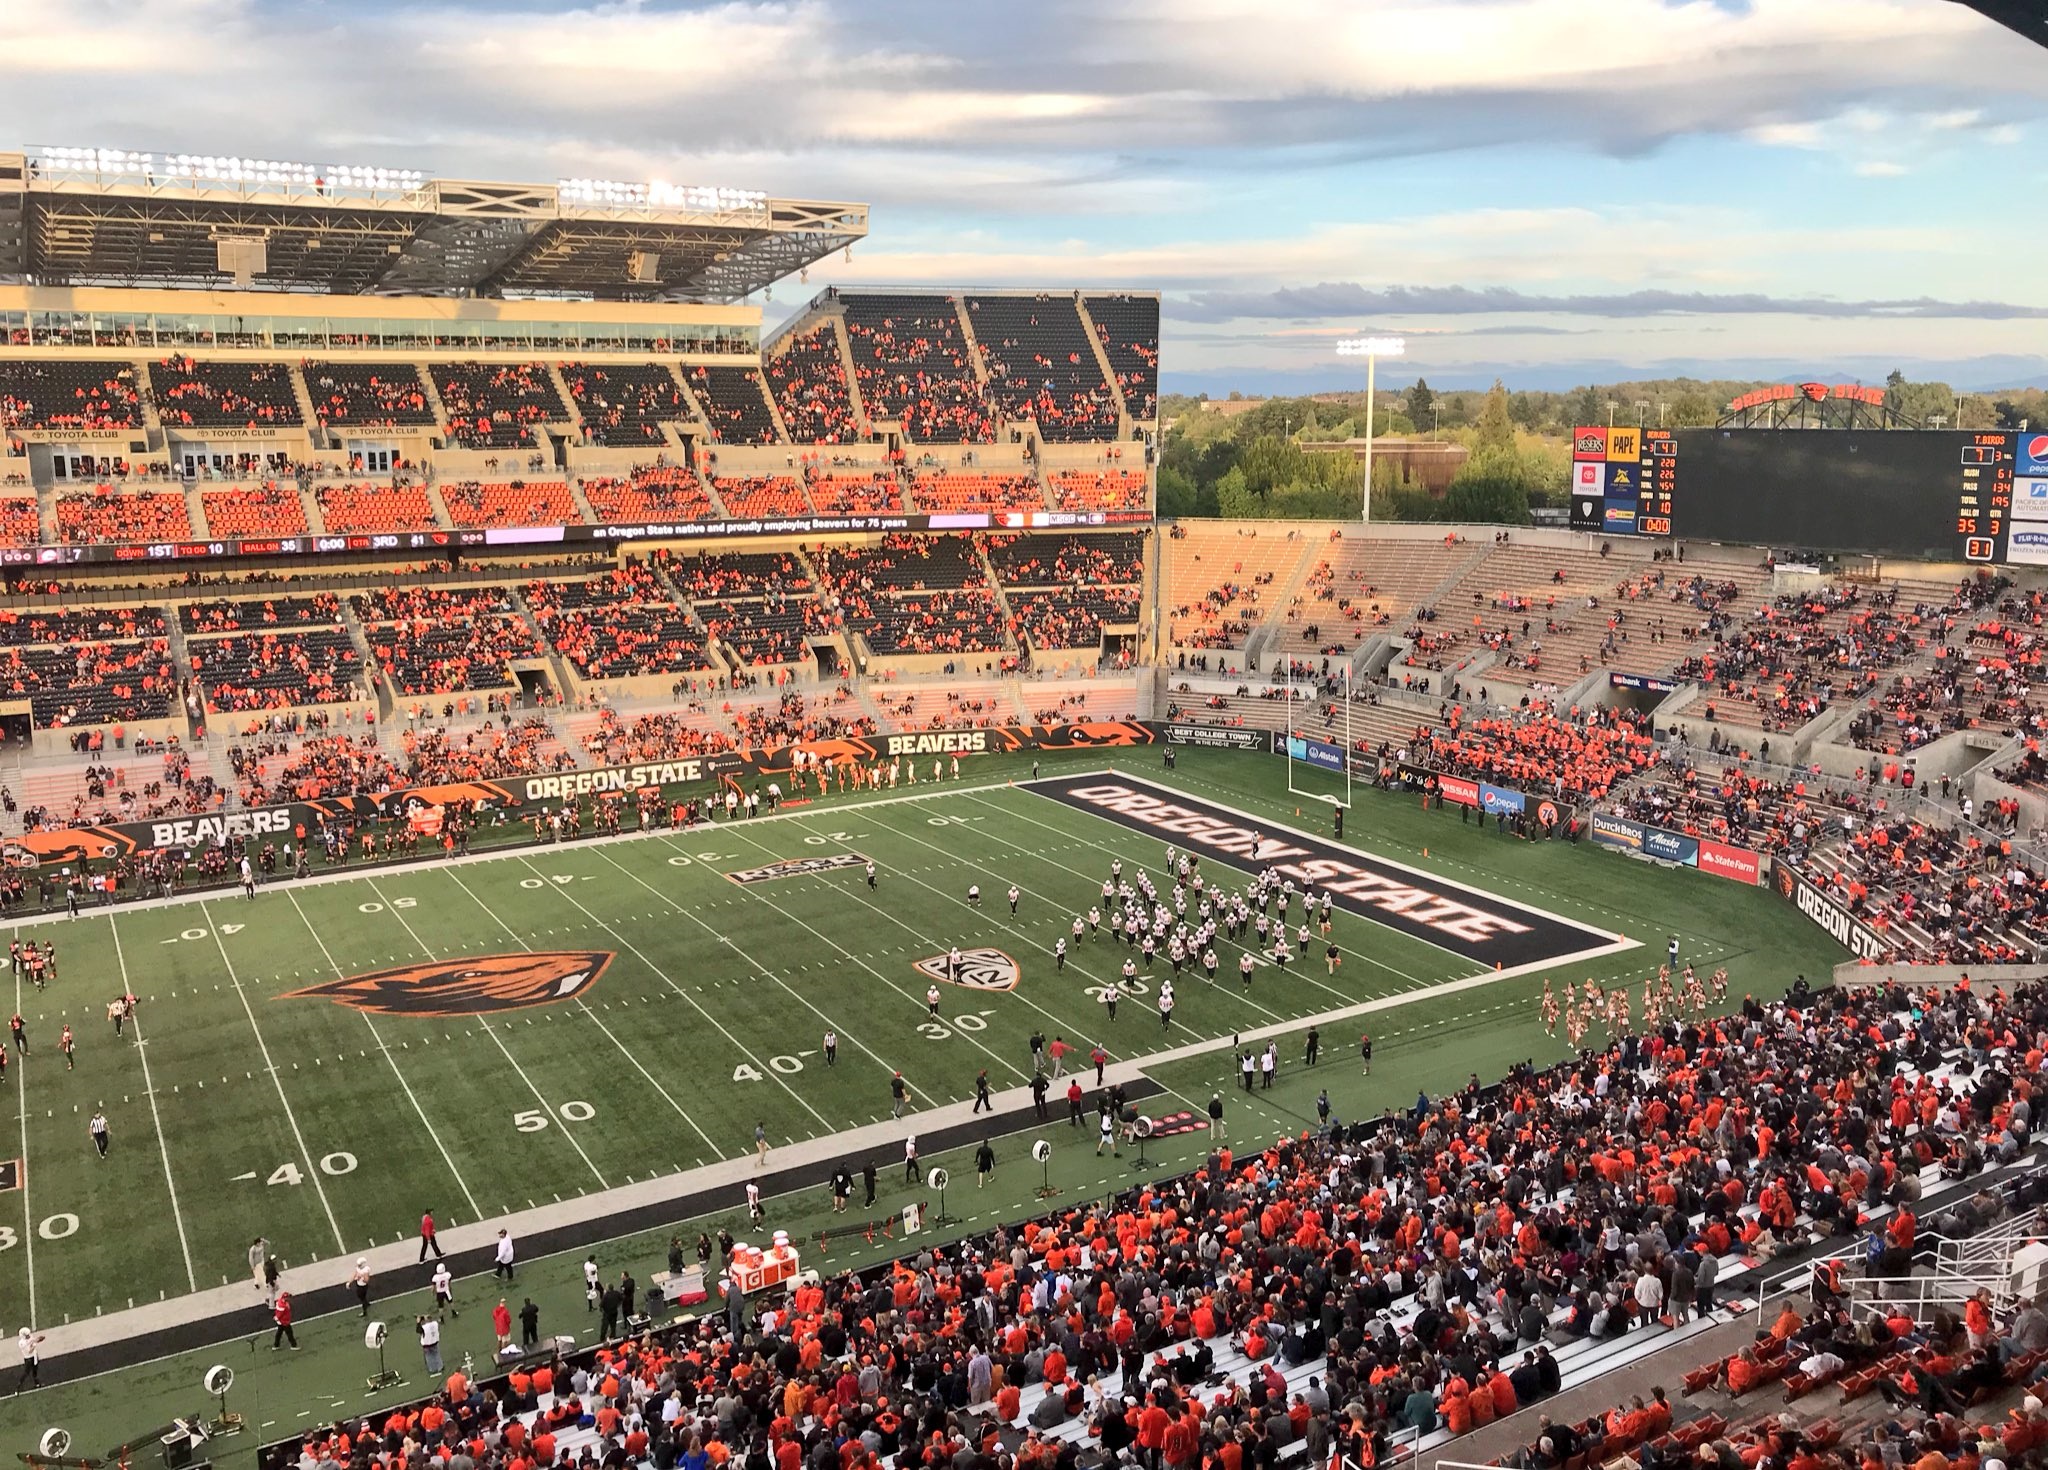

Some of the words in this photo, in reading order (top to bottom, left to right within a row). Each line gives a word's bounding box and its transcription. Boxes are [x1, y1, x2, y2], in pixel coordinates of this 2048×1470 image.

[1732, 384, 1795, 410] OREGON
[1835, 383, 1886, 406] STATE
[49, 431, 89, 439] TOYOTA
[1662, 442, 1676, 453] 41
[1975, 448, 1984, 462] 7
[1995, 451, 2002, 461] 3
[1660, 459, 1676, 467] 228
[1659, 470, 1675, 478] 226
[1997, 469, 2012, 479] 61
[1659, 481, 1674, 490] 454
[1963, 482, 1978, 491] PASS
[1992, 483, 2011, 493] 134
[1660, 501, 1672, 514] 10
[1961, 496, 1978, 505] TOTAL
[1992, 497, 2009, 507] 195
[608, 526, 646, 538] Oregon
[646, 525, 674, 535] State
[675, 523, 706, 534] native
[707, 523, 726, 533] and
[727, 521, 763, 535] proudly
[764, 519, 811, 532] employing
[812, 518, 850, 529] Beavers
[851, 517, 866, 528] for
[881, 518, 907, 529] years
[1647, 519, 1669, 532] 0:00
[1958, 518, 1976, 533] 35
[1991, 520, 2000, 535] 3
[243, 542, 266, 552] BALL
[267, 542, 280, 551] ON
[281, 540, 296, 551] 35
[319, 539, 345, 550] 0:00
[352, 538, 370, 547] QTR
[373, 536, 398, 547] 3RD
[411, 535, 424, 546] 41
[72, 549, 82, 560] 7
[116, 548, 145, 558] DOWN
[147, 545, 172, 557] 1ST
[180, 546, 193, 555] TO
[208, 543, 223, 555] 10
[1970, 541, 1990, 555] 31
[1174, 728, 1194, 736] BEST
[1194, 730, 1227, 739] COLLEGE
[1228, 732, 1251, 741] TOWN
[888, 732, 986, 755] BEAVERS
[1318, 751, 1339, 763] Allstate
[526, 768, 626, 800] OREGON
[631, 760, 702, 788] STATE
[1438, 781, 1477, 799] NISSAN
[1495, 797, 1518, 810] pepsi
[1542, 809, 1554, 819] 76
[1648, 833, 1681, 849] Alaska
[1650, 843, 1677, 855] AIRLINES
[730, 855, 857, 882] RESER
[1067, 785, 1314, 861] OREGON
[1275, 859, 1536, 943] STATE
[520, 874, 574, 889] 40
[359, 897, 418, 913] 50
[1797, 882, 1850, 945] OREGON
[181, 923, 246, 940] 40
[916, 1015, 988, 1040] 30
[733, 1055, 804, 1082] 40
[513, 1101, 596, 1132] 50
[266, 1152, 358, 1186] 40
[747, 1271, 761, 1287] G
